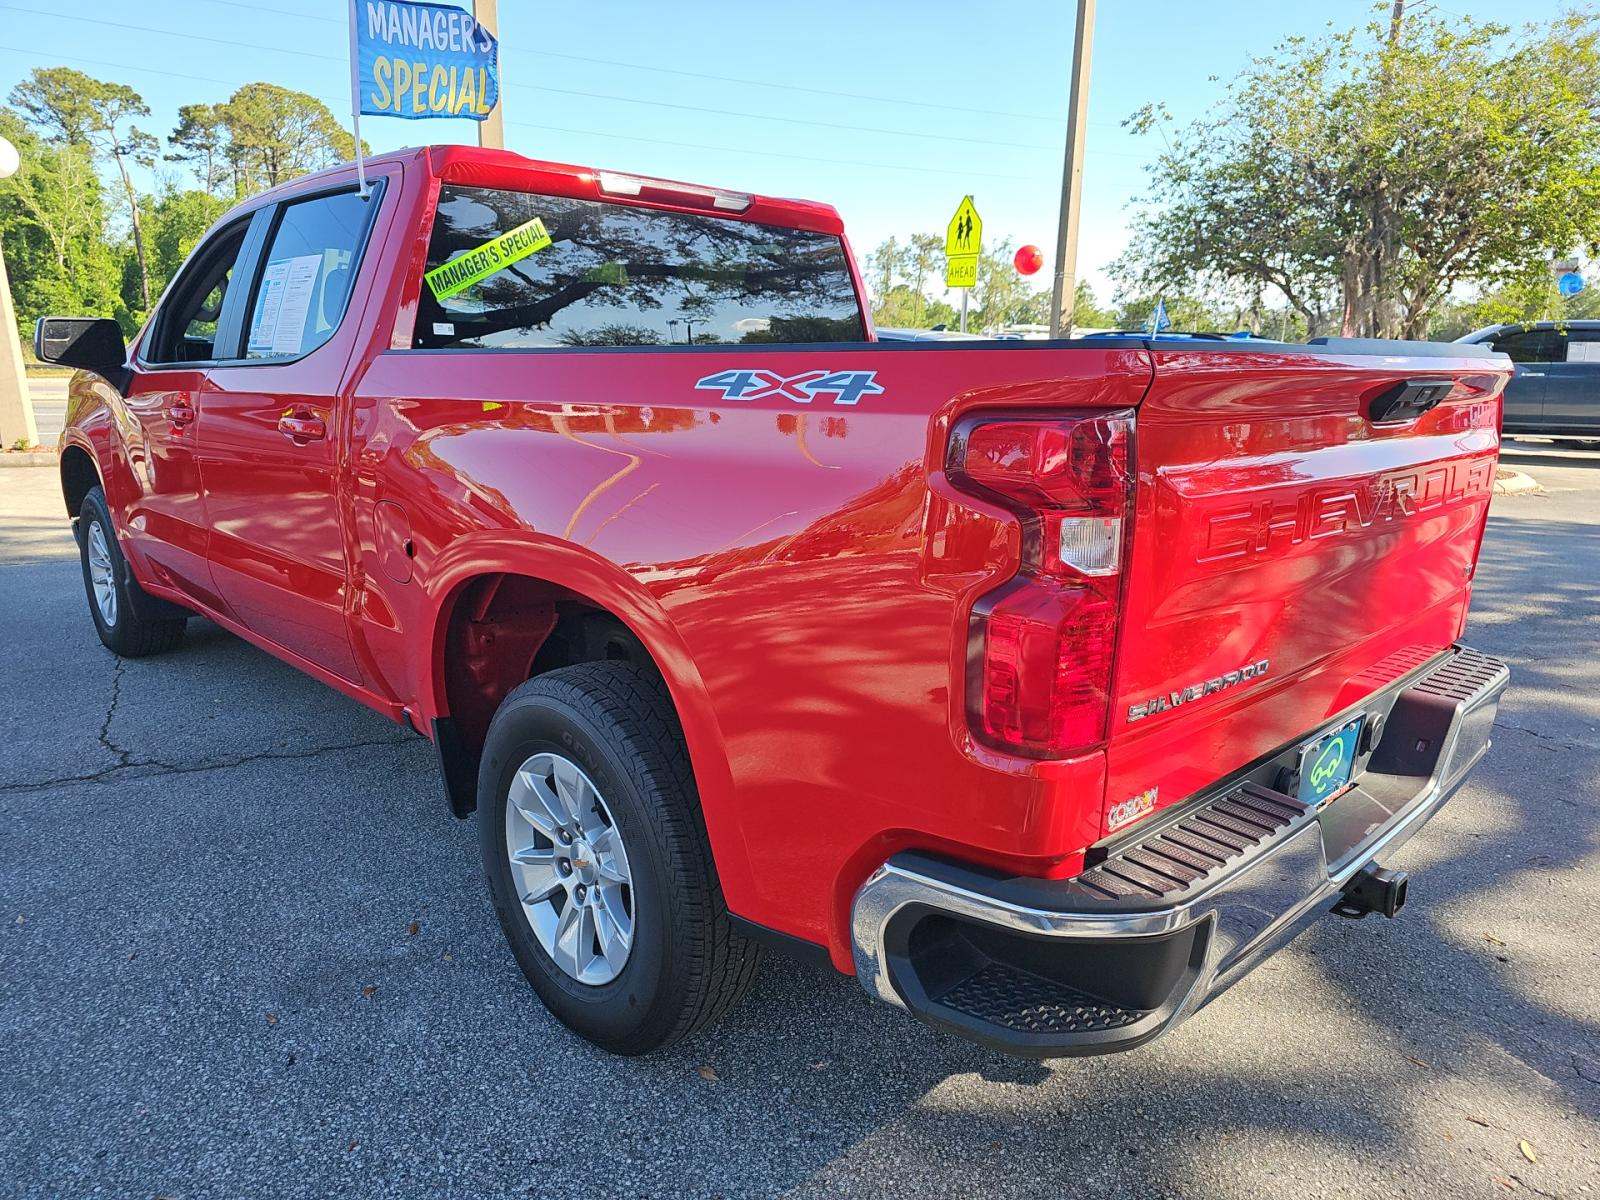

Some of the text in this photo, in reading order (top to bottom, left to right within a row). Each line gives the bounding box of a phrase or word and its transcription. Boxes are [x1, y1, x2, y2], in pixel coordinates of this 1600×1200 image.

[366, 2, 492, 53] MANAGER'S
[371, 56, 490, 114] SPECIAL
[430, 223, 545, 294] MANAGER'S SPECIAL
[949, 266, 975, 278] AHEAD
[1196, 455, 1496, 564] CHEVROLET
[1126, 659, 1270, 723] SILVERADO
